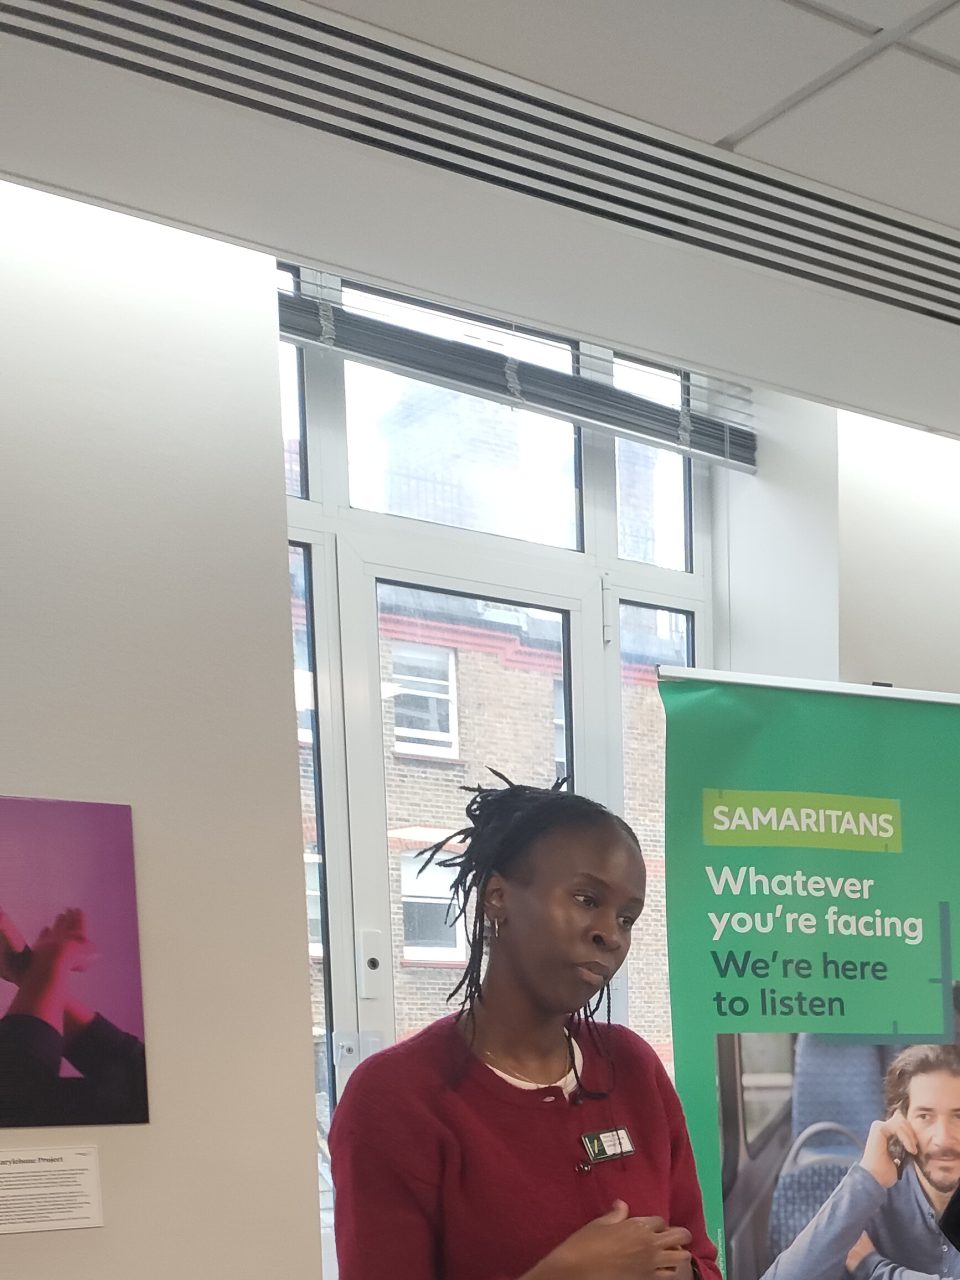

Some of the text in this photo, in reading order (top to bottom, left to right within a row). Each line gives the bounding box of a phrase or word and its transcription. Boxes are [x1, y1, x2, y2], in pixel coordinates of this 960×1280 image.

[713, 806, 894, 838] SAMARITANS
[706, 866, 874, 899] Whatever
[708, 905, 923, 945] you're facing
[710, 950, 888, 981] We're here
[713, 989, 845, 1018] to listen
